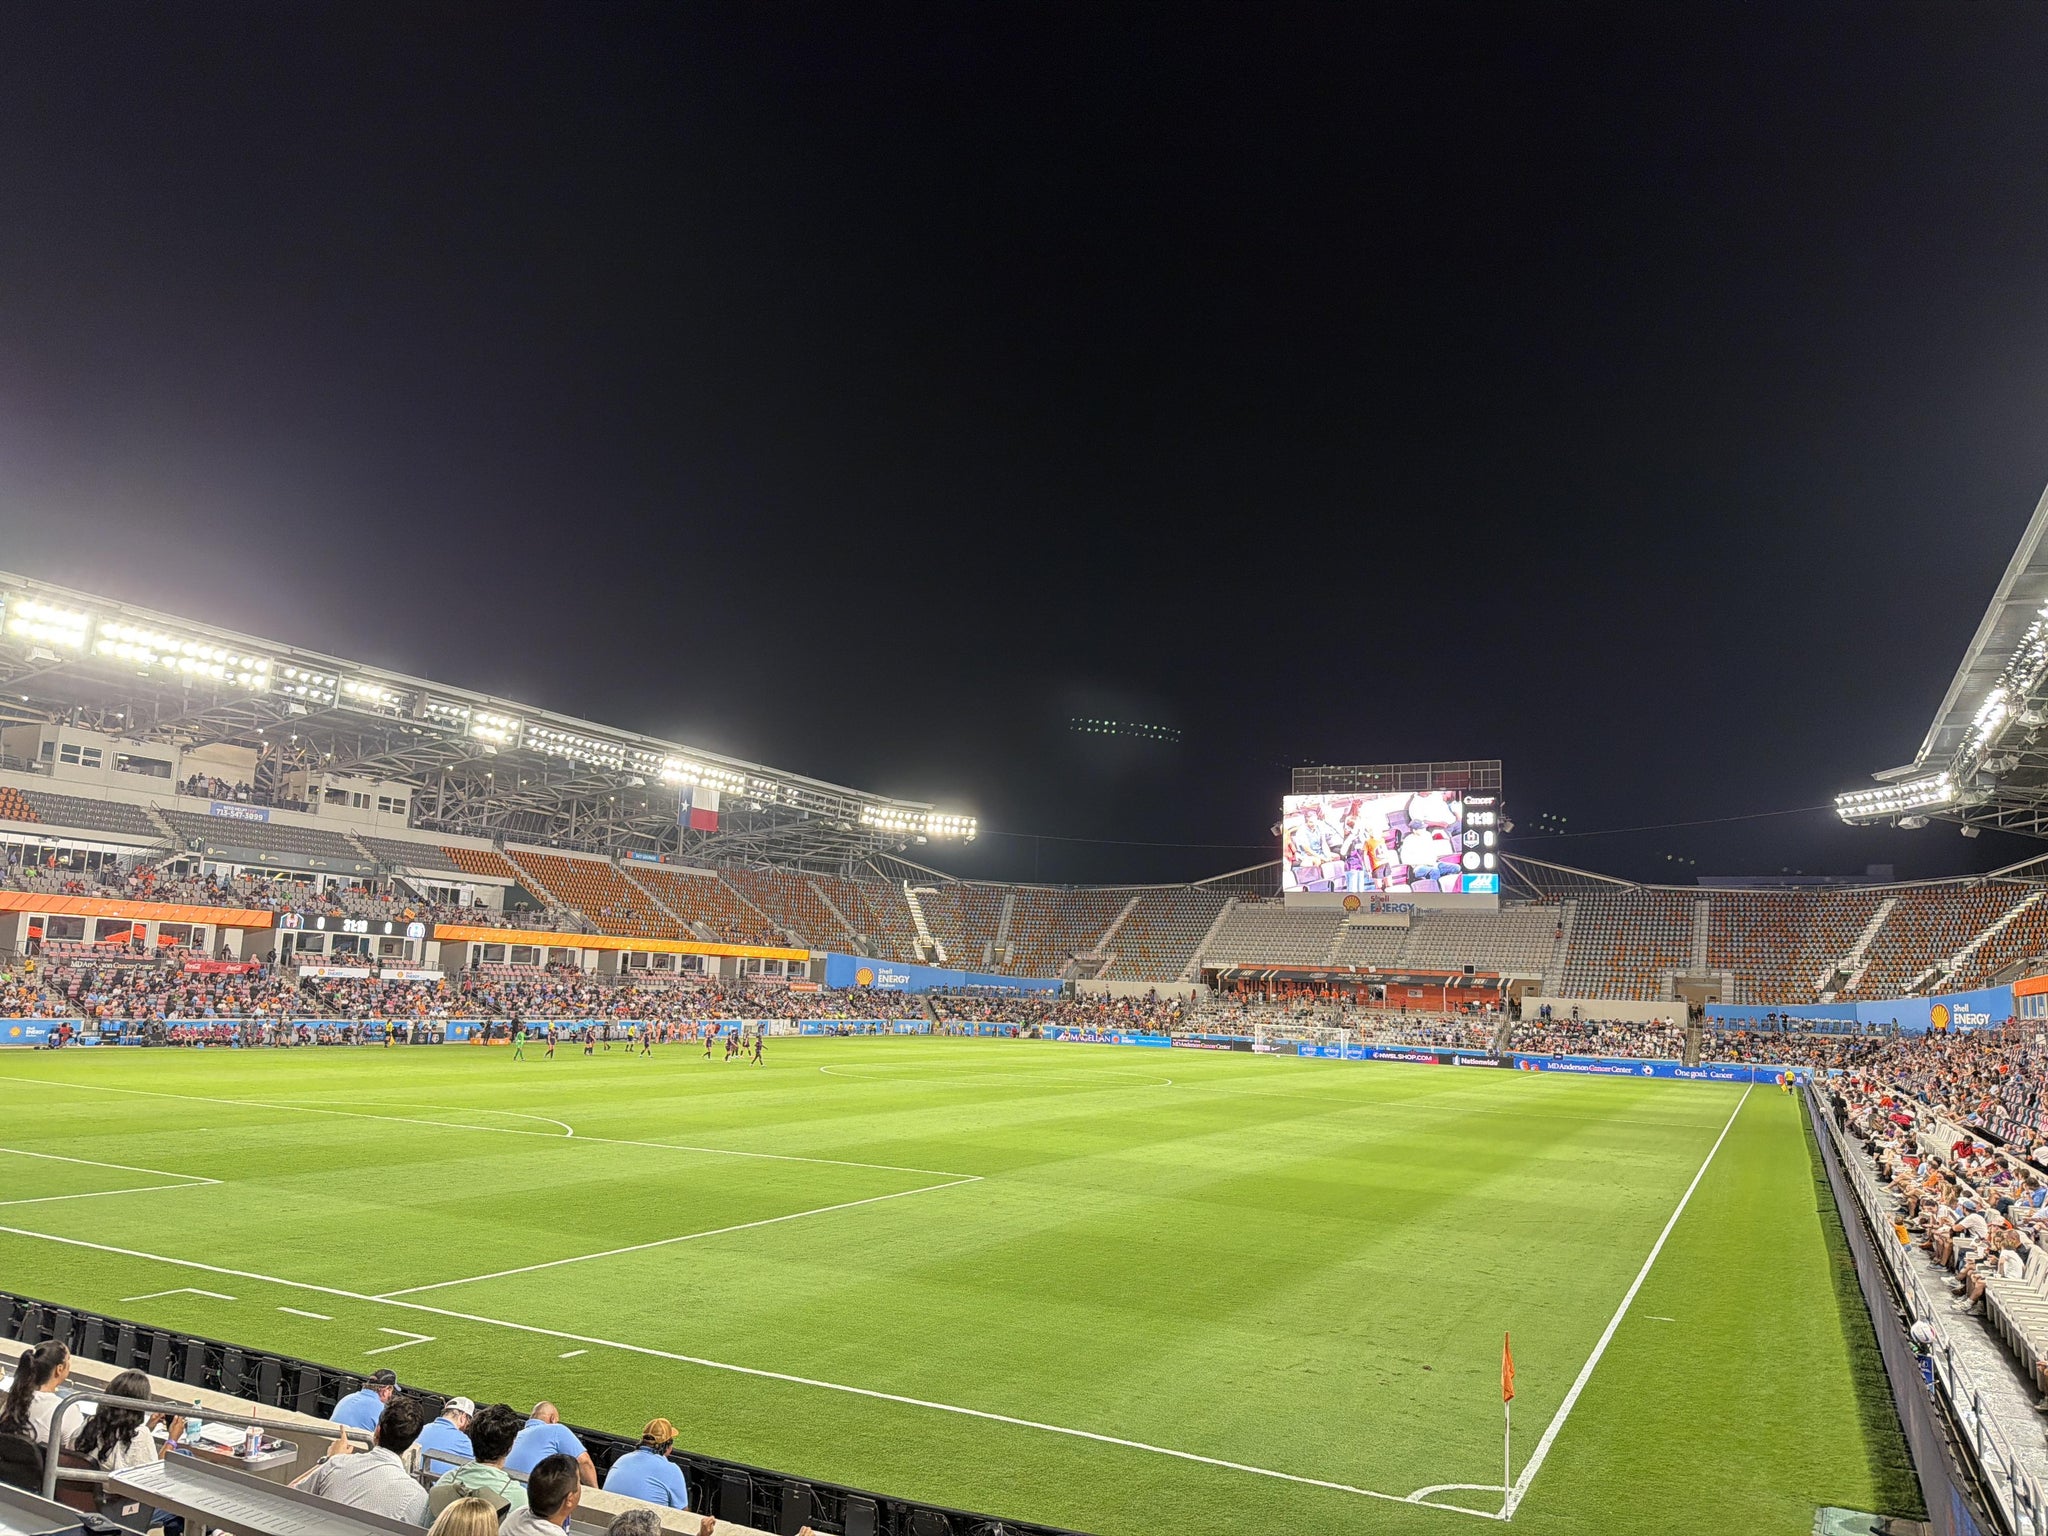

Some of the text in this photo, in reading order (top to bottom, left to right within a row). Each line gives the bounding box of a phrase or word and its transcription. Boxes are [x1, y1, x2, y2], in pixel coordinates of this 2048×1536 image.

[216, 808, 263, 821] 713-547-3099
[316, 917, 325, 930] 0
[384, 922, 393, 934] 0
[878, 975, 910, 984] ENERGY
[1953, 1004, 1969, 1012] Shell
[1954, 1014, 1991, 1025] ENERGY
[1070, 1034, 1111, 1042] MAGELLAN
[1461, 1058, 1499, 1066] Nationwide
[1560, 1063, 1589, 1071] Anderson
[1674, 1068, 1734, 1079] One goal: Cancer
